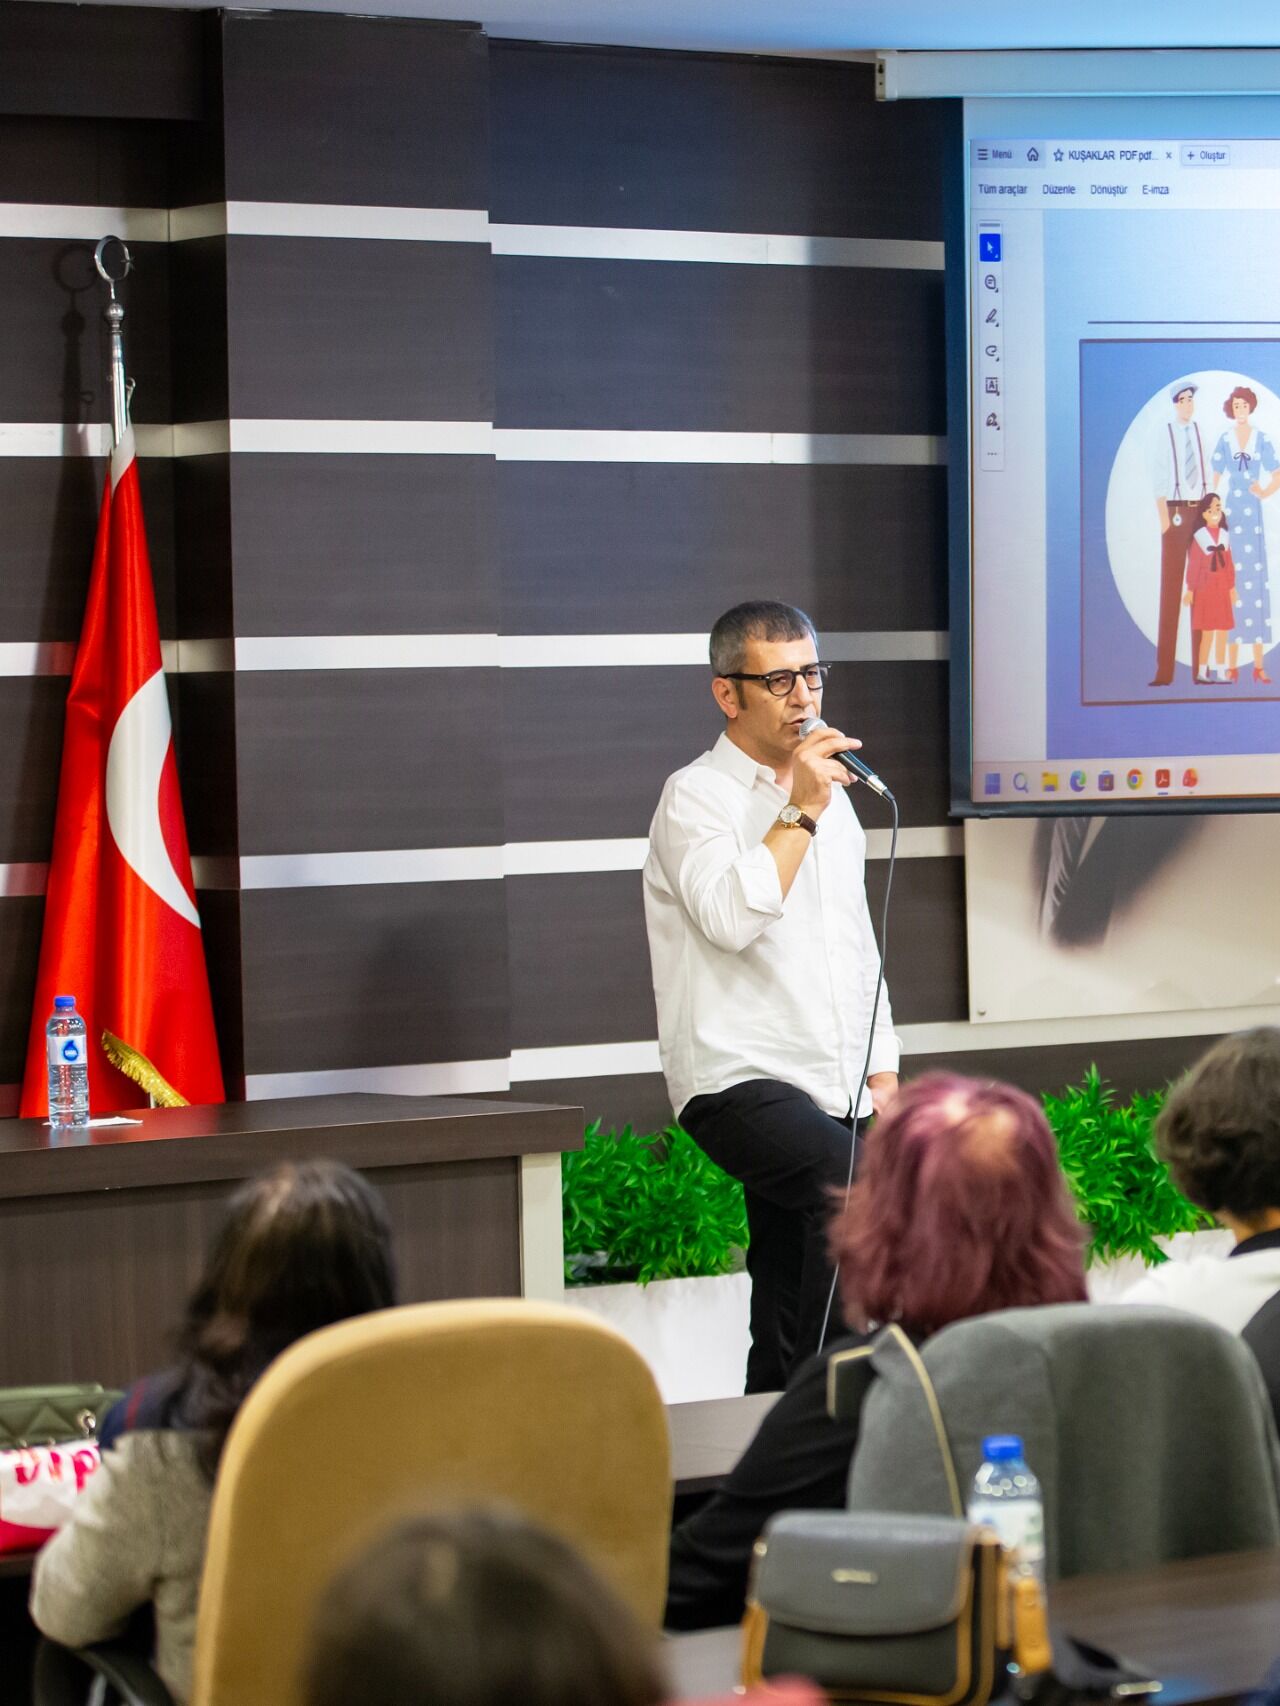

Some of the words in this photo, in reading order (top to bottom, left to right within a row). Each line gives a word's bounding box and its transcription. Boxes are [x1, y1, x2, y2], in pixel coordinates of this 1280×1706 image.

[1068, 150, 1115, 162] KUŞAKLAR
[1199, 151, 1226, 162] Oluştur
[978, 184, 997, 195] Tüm
[998, 184, 1028, 197] araçlar
[1042, 184, 1076, 195] Düzenle
[1090, 184, 1128, 197] Dönüştür
[1142, 185, 1170, 195] E-imza
